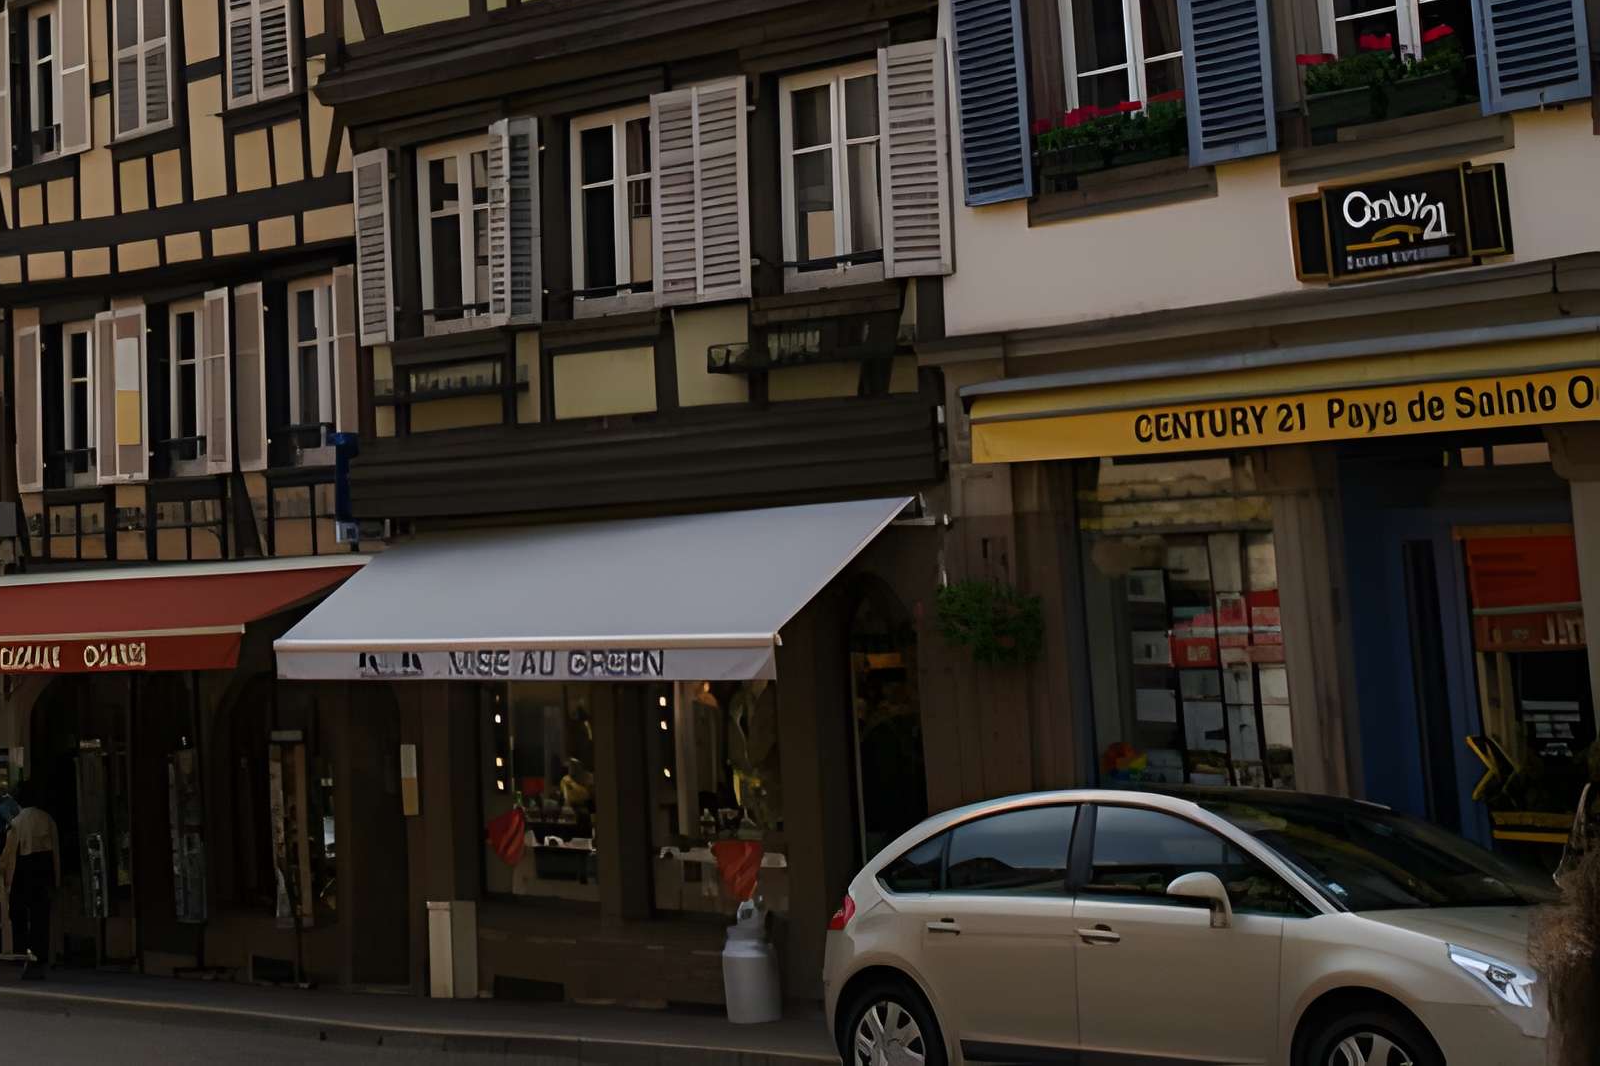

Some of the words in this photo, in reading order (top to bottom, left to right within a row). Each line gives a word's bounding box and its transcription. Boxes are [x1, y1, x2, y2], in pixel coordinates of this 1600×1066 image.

[1420, 201, 1448, 240] 21
[1134, 405, 1268, 443] CENTURY
[1277, 402, 1306, 432] 21
[1407, 390, 1445, 422] de
[521, 649, 555, 676] AU
